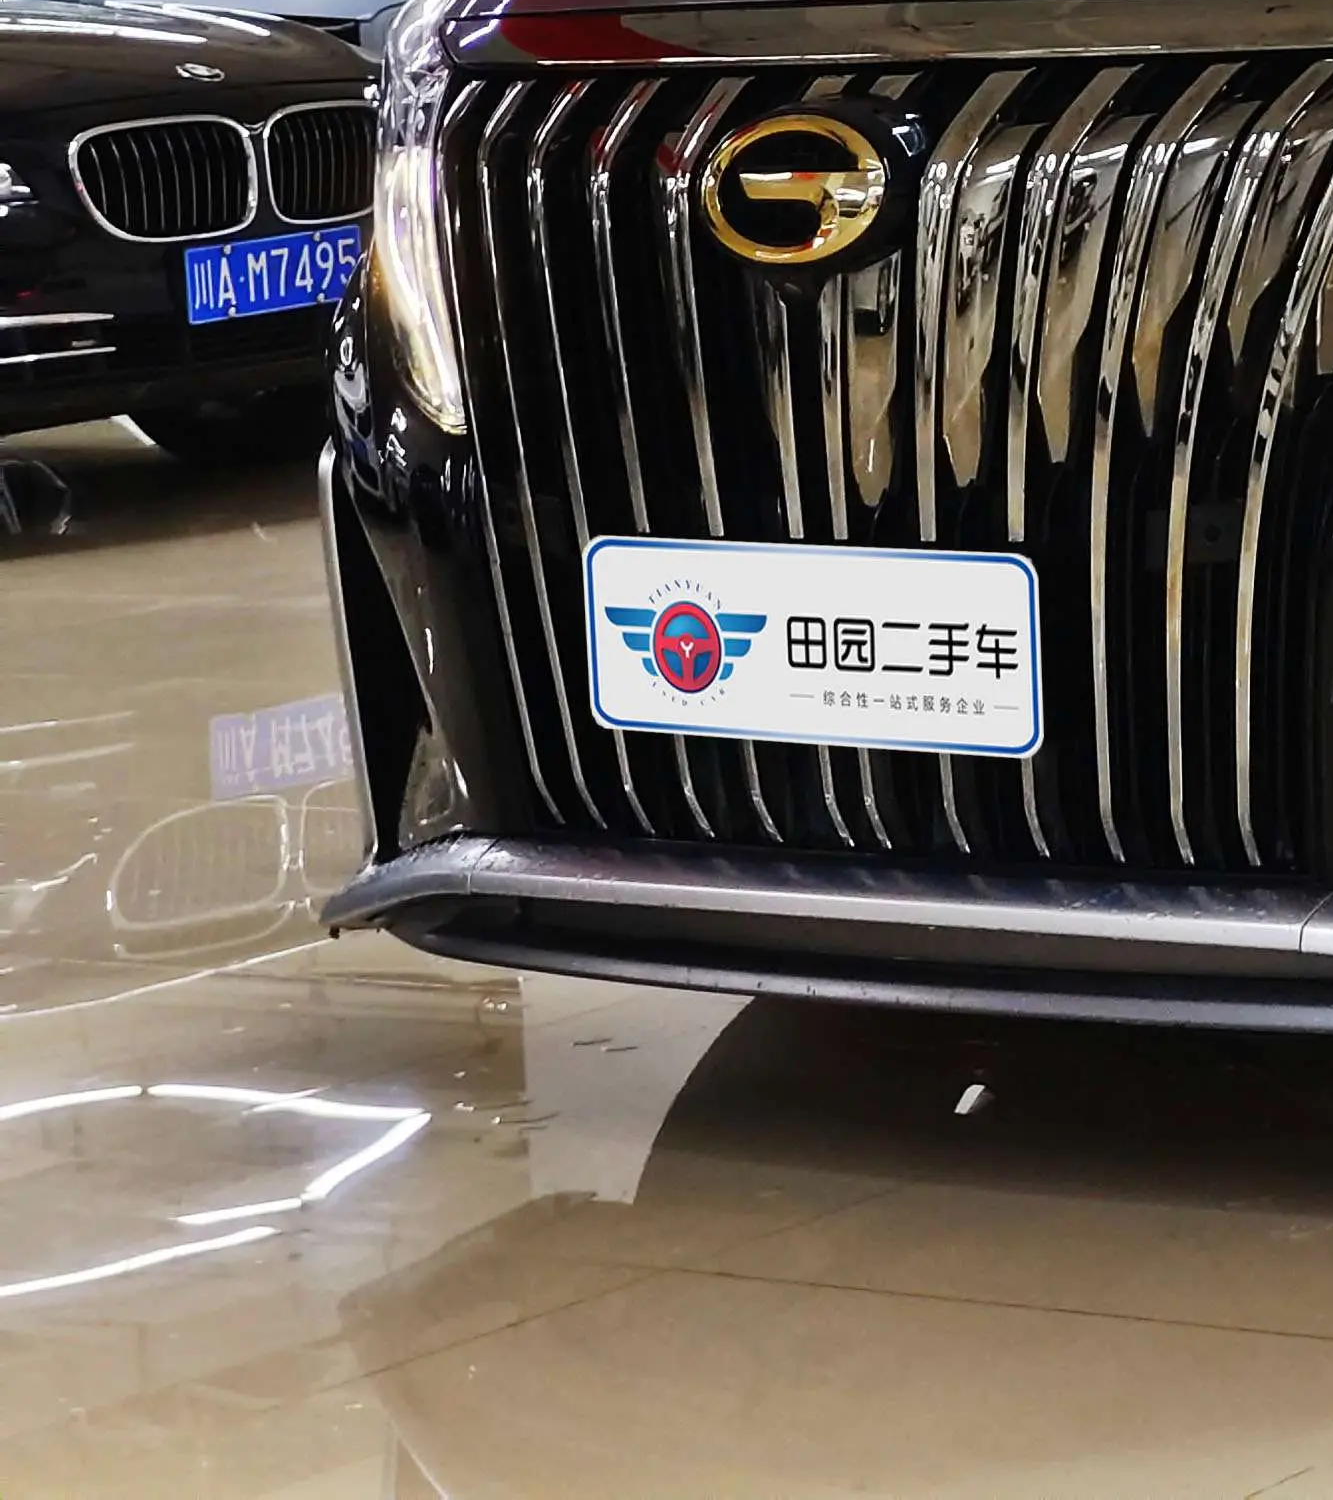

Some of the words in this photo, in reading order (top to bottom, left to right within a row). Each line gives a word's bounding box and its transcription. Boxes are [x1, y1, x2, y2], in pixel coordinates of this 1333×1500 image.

[787, 615, 1019, 679] 田园二手车
[822, 690, 986, 715] 综合性一站式服务企业
